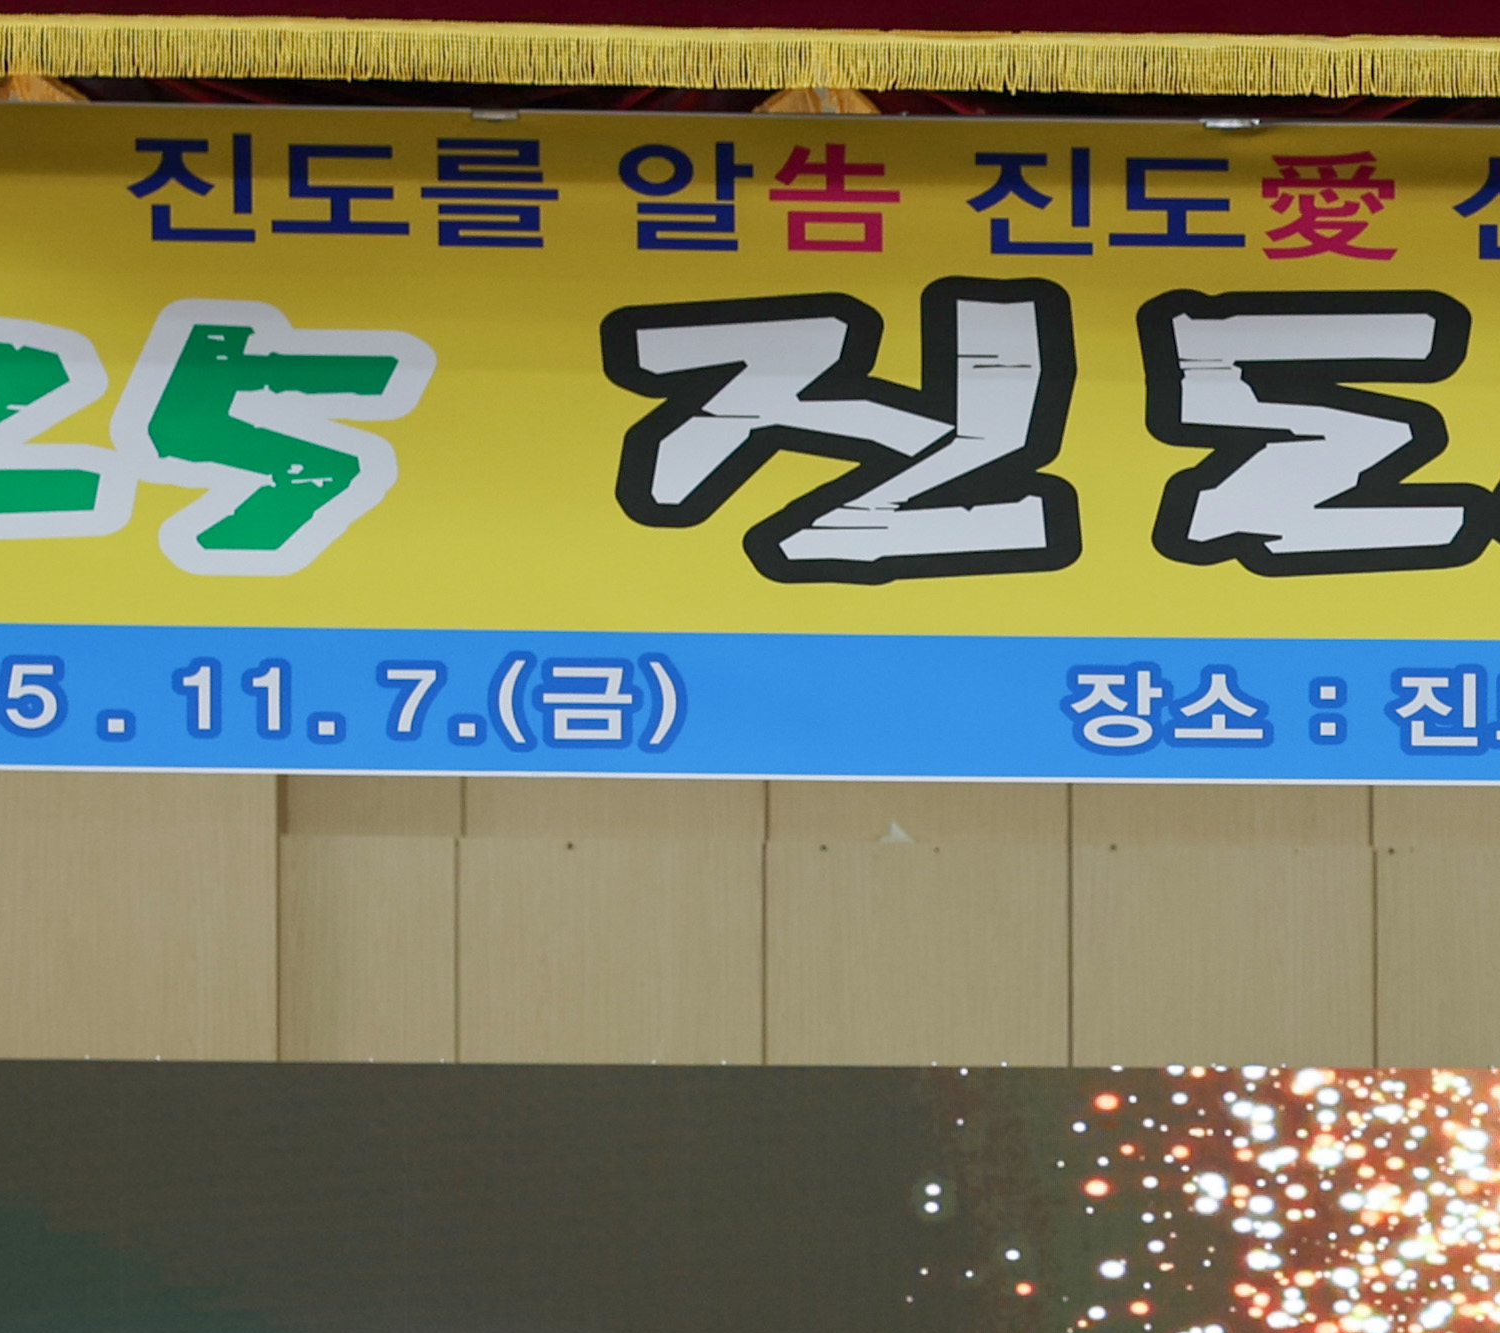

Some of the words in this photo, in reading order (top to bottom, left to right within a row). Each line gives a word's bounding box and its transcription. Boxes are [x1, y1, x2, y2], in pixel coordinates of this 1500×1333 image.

[128, 132, 559, 248] 진도를
[618, 141, 900, 252] 알告
[966, 147, 1398, 261] 진도愛
[1070, 670, 1264, 747] 장소
